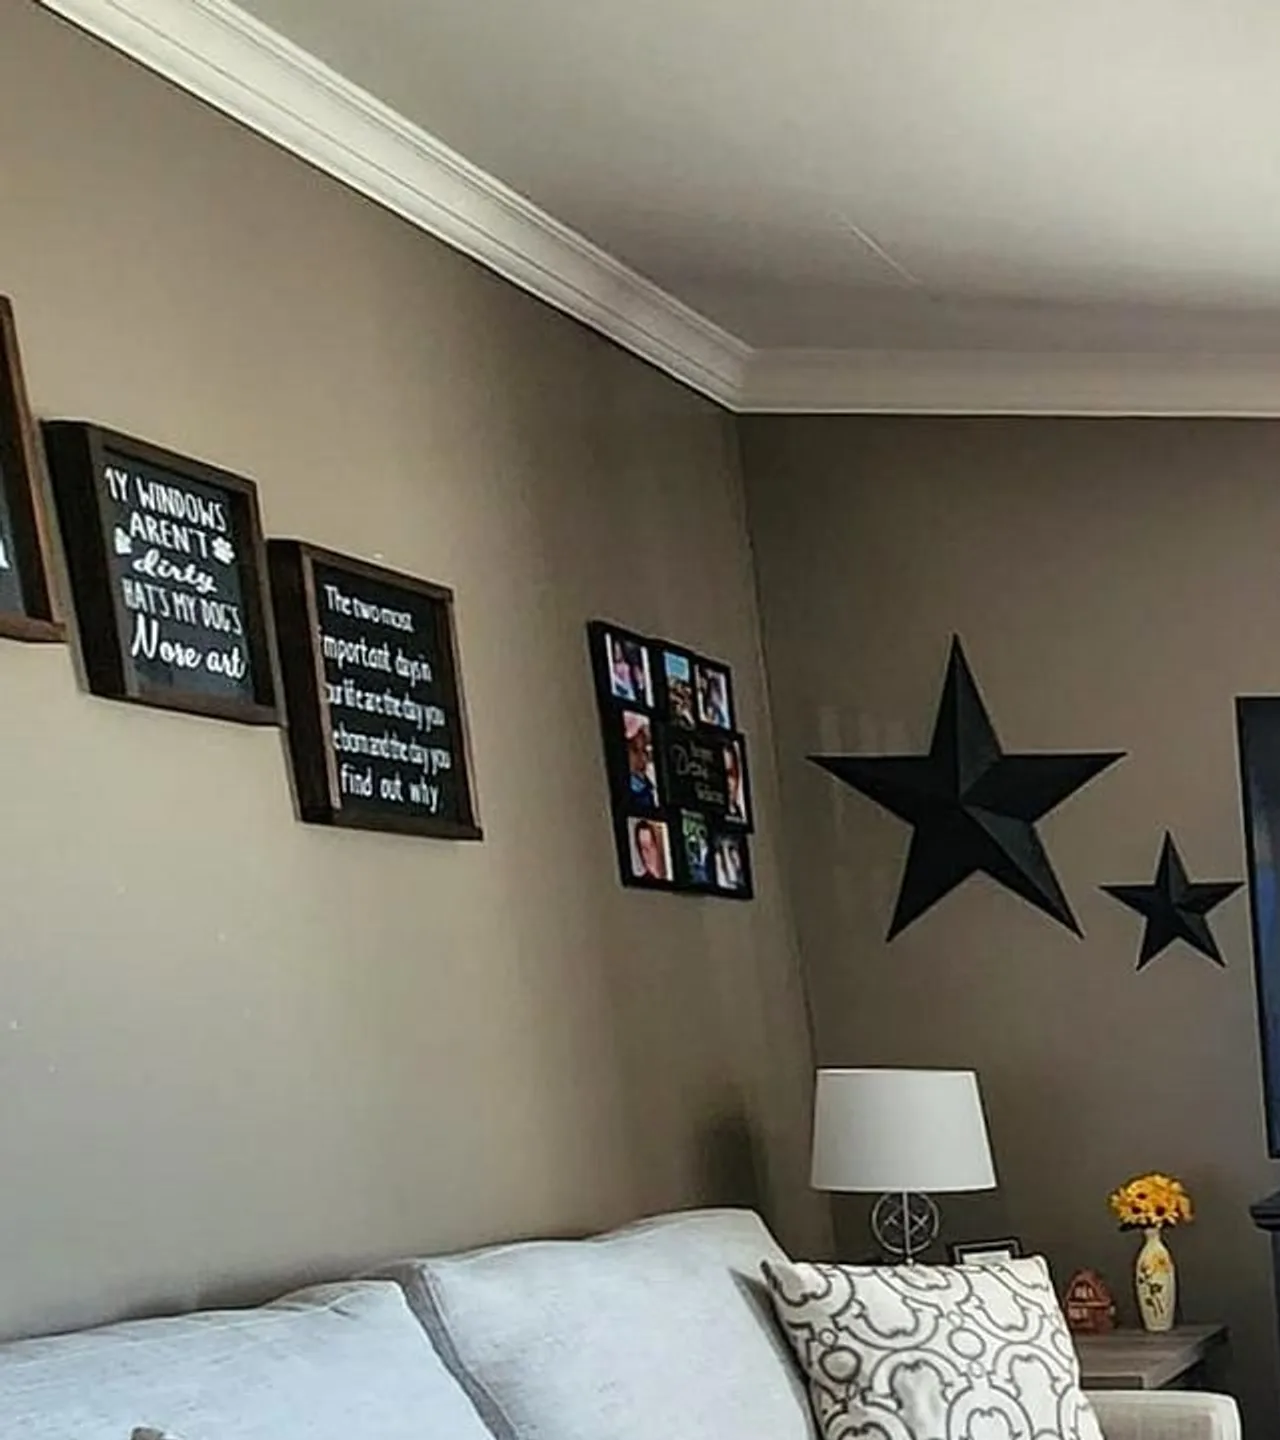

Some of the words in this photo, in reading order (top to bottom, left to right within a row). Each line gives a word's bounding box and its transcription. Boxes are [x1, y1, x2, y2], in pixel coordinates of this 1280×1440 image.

[136, 476, 226, 532] WINDOWS
[130, 511, 208, 559] AREN'T
[132, 547, 217, 593] dirty
[172, 591, 197, 625] MY
[200, 598, 242, 635] DOG'S
[324, 584, 351, 615] The
[352, 597, 379, 623] two
[132, 612, 202, 668] Nose
[206, 646, 246, 679] art
[341, 762, 372, 796] find
[380, 770, 404, 802] out
[408, 775, 438, 813] why
